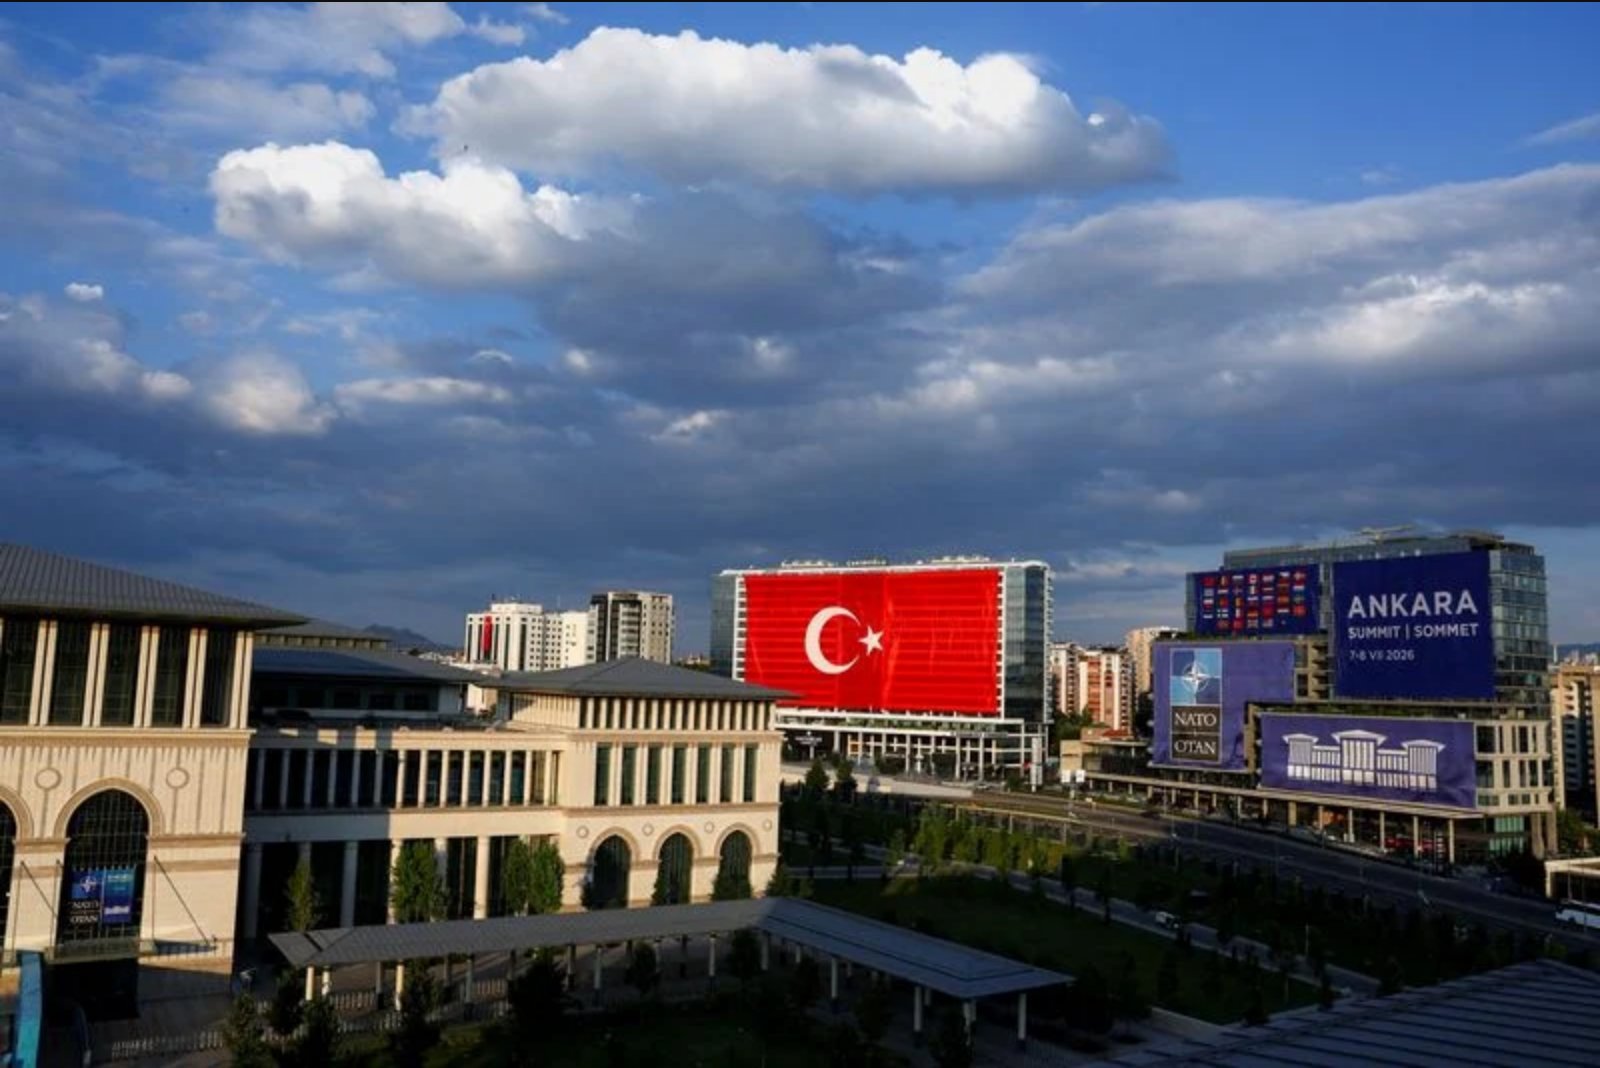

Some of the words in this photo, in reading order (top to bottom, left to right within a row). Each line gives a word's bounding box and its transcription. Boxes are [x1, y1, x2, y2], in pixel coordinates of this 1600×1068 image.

[1348, 589, 1479, 619] ANKARA
[1348, 625, 1400, 639] SUMMIT
[1414, 623, 1478, 638] SOMMET
[1386, 649, 1415, 661] 2026
[1174, 712, 1217, 727] NATO
[1174, 740, 1217, 755] OTAN
